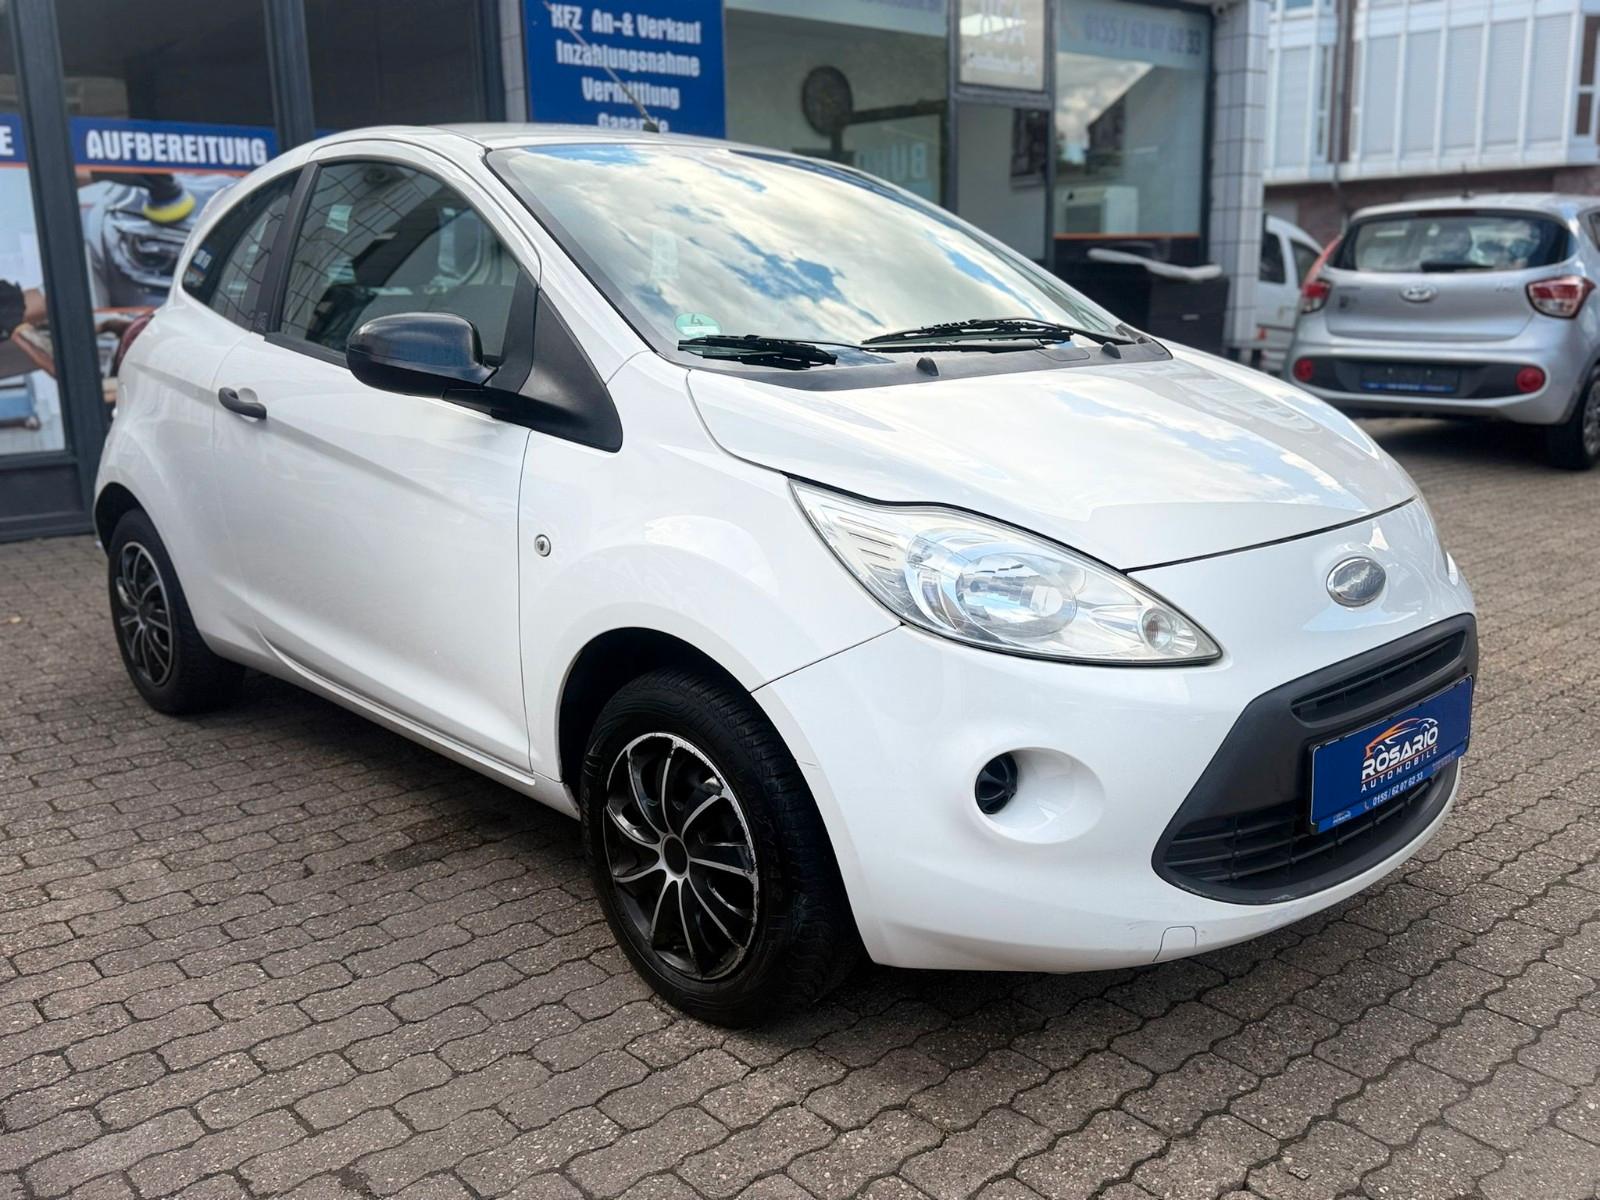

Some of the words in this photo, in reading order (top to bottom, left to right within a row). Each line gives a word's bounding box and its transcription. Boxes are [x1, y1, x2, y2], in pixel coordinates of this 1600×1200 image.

[552, 3, 583, 30] KFZ
[637, 14, 702, 44] Verkauf
[556, 39, 700, 77] Inzahlungsnahme
[582, 76, 680, 110] Vermittlung
[86, 129, 267, 166] AUFBEREITUNG
[690, 313, 704, 326] 4
[1361, 745, 1437, 793] AUTOMOBILE
[1362, 727, 1438, 780] ROSARIO
[1372, 790, 1388, 806] 0155
